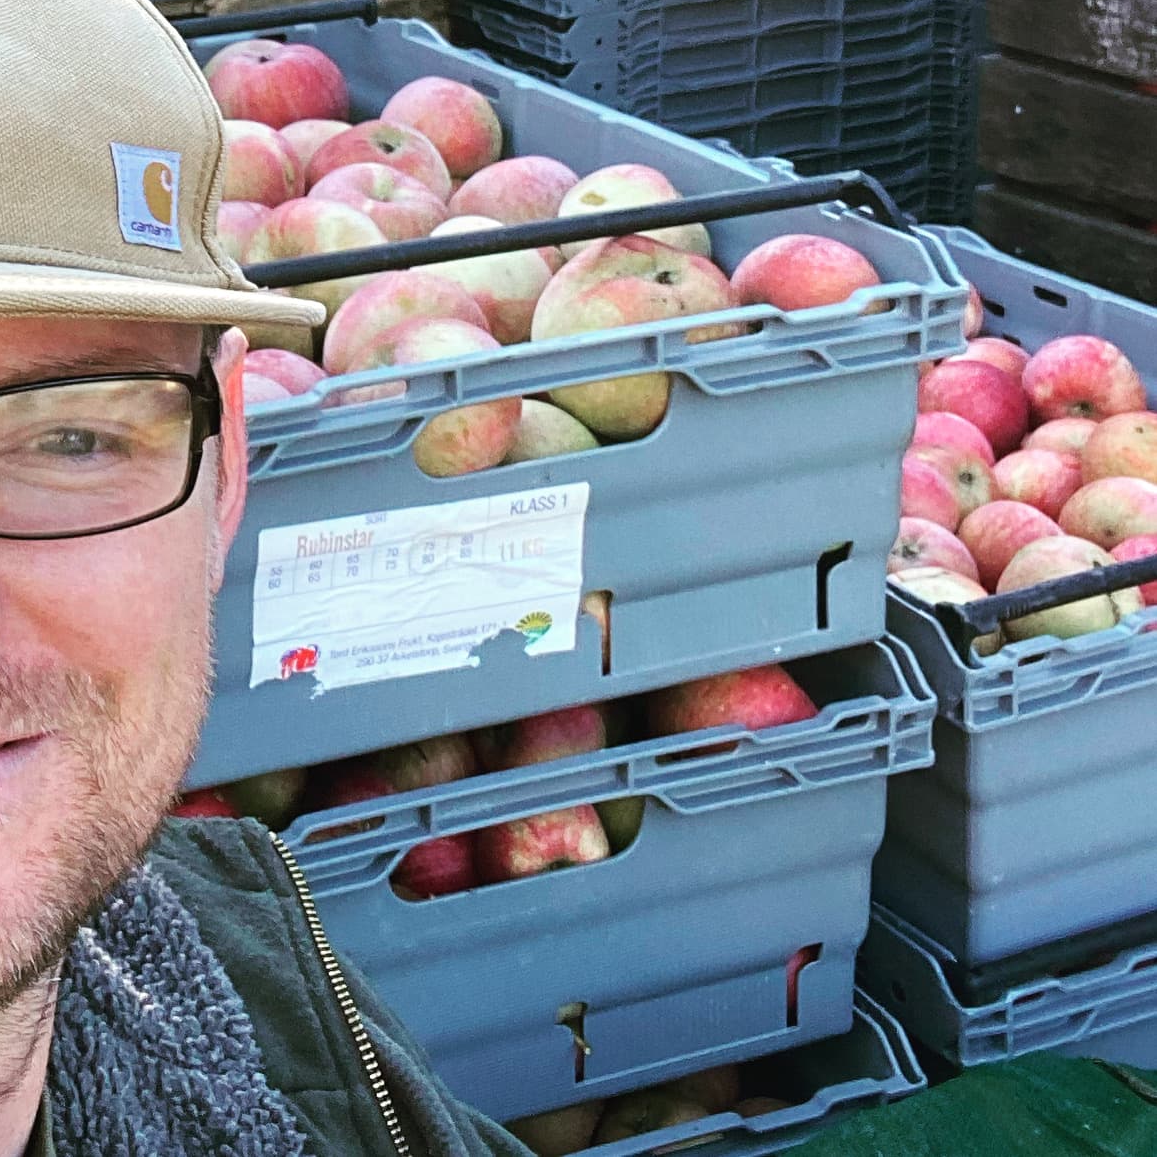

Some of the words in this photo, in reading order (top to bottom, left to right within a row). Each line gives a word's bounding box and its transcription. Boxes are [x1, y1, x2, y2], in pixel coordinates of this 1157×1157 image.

[510, 495, 556, 516] KLASS
[561, 492, 568, 508] 1
[296, 528, 375, 559] Rubinstar
